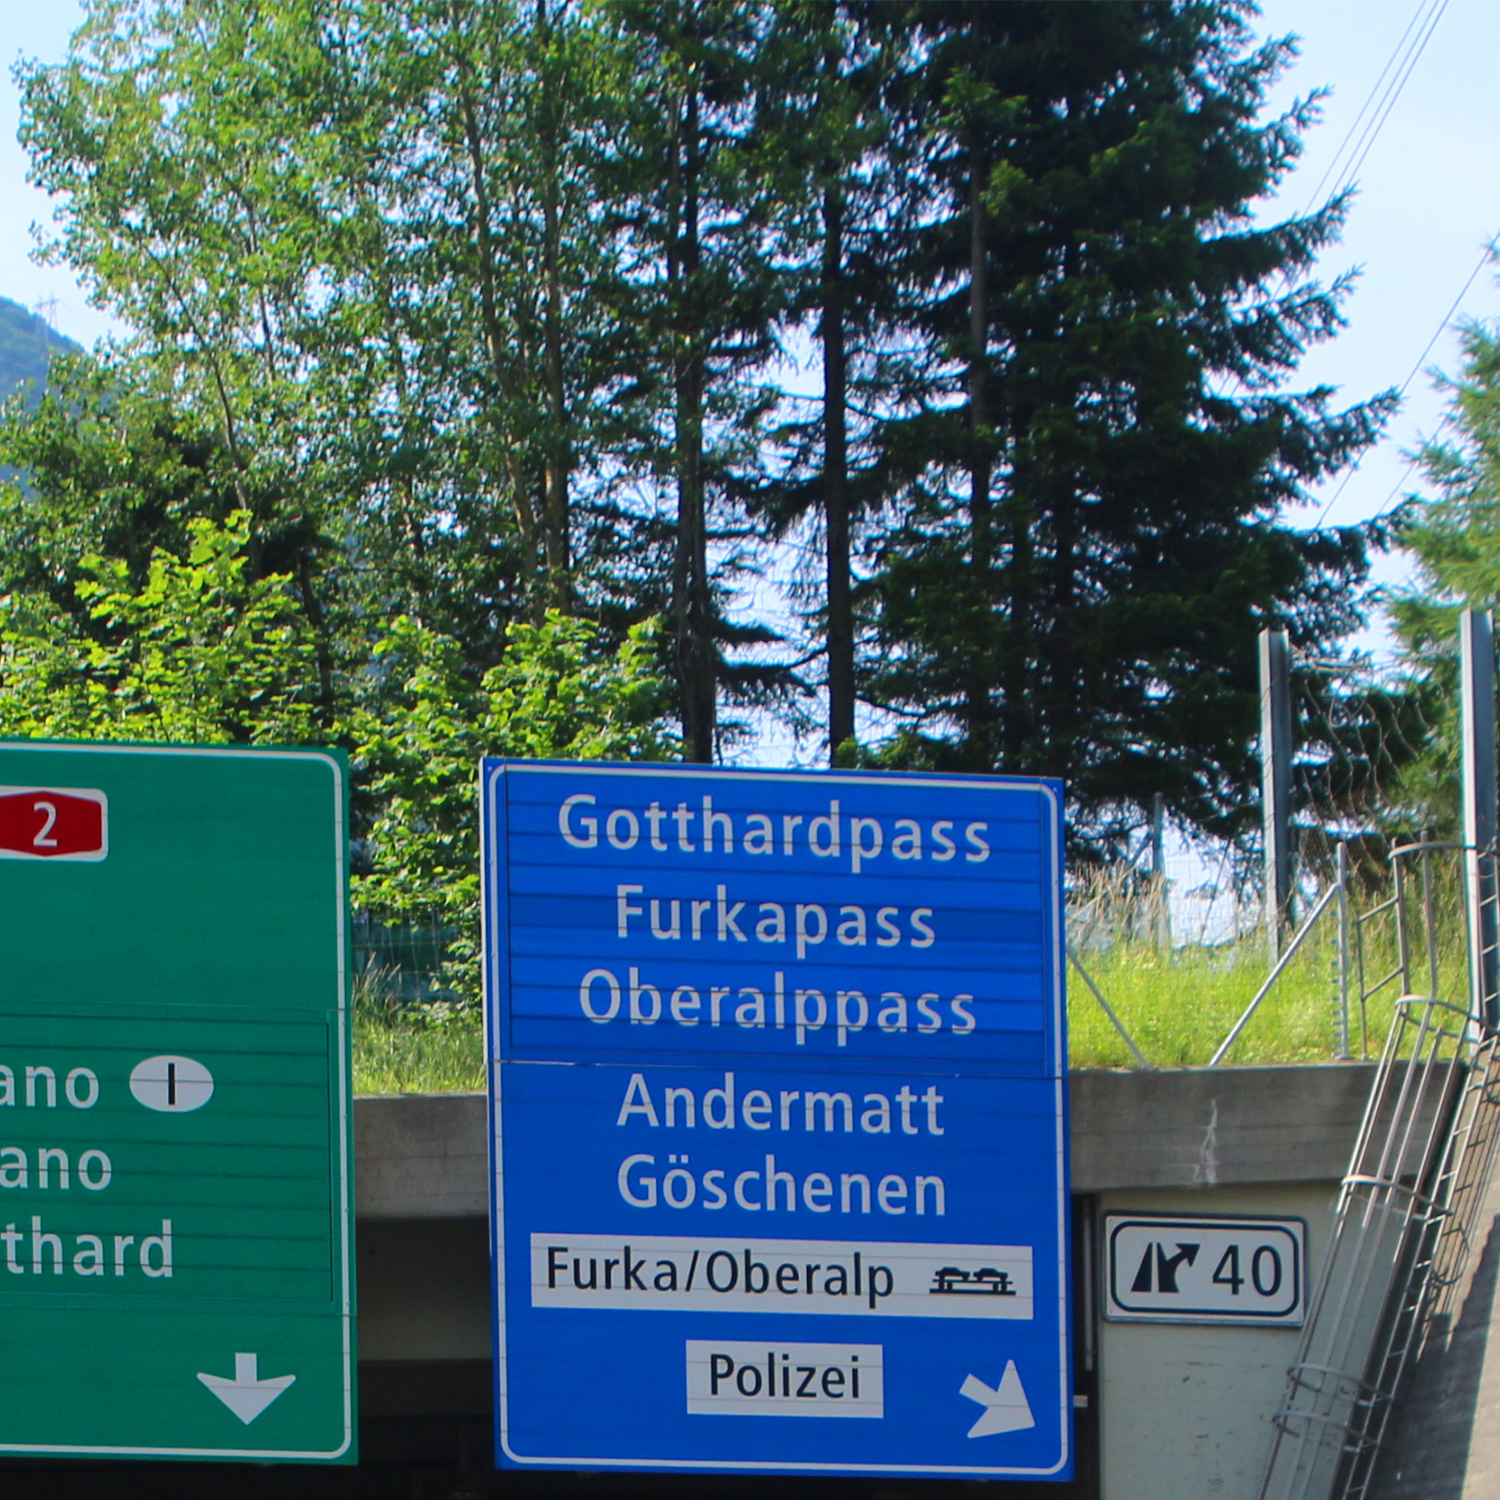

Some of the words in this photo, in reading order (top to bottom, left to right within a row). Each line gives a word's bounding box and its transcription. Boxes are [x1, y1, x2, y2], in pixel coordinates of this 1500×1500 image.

[32, 800, 59, 848] 2
[558, 793, 991, 873] Gotthardpass
[616, 883, 936, 959] Furkapass
[579, 966, 977, 1047] Oberalppass
[616, 1071, 946, 1136] Andermatt
[617, 1153, 946, 1217] Göschenen
[546, 1245, 895, 1310] Furka/Oberalp
[1212, 1244, 1283, 1297] 40
[709, 1351, 860, 1400] Polizei
